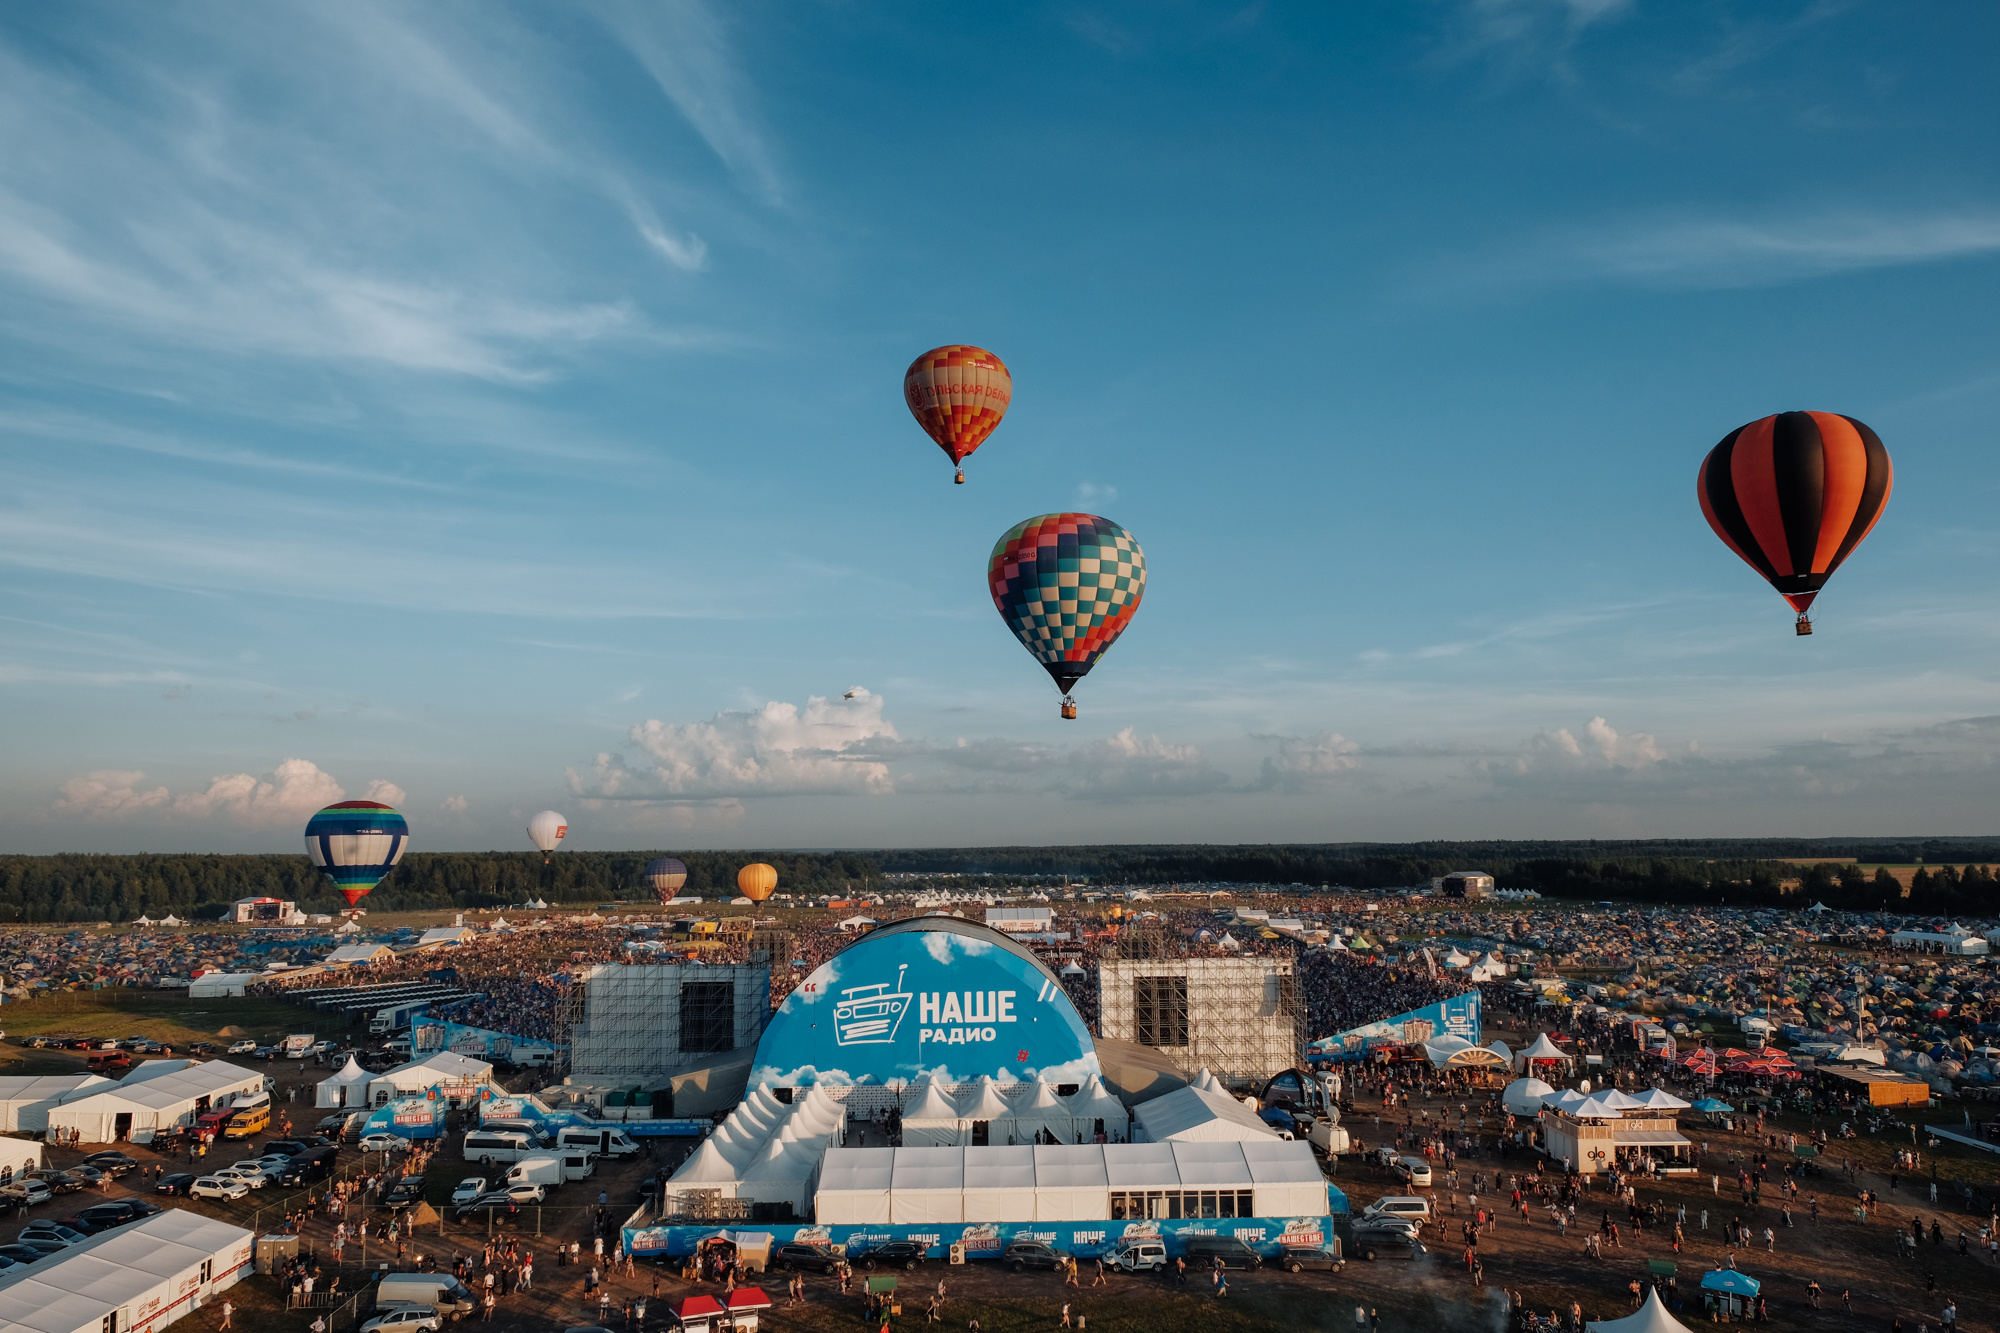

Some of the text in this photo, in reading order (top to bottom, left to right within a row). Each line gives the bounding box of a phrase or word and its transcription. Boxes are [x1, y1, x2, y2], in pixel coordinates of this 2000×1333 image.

[924, 384, 983, 398] ТУЛЬСКАЯ
[920, 990, 1017, 1024] НАШЕ
[920, 1027, 997, 1045] РАДИО
[1631, 1119, 1642, 1131] glo
[1588, 1146, 1606, 1161] glo
[1034, 1232, 1057, 1241] НАШЕ
[1074, 1231, 1106, 1244] НАШЕ
[1195, 1228, 1217, 1236] НАШЕ
[1234, 1228, 1266, 1241] НАШЕ
[1281, 1233, 1322, 1244] НАШЕСТВИЕ
